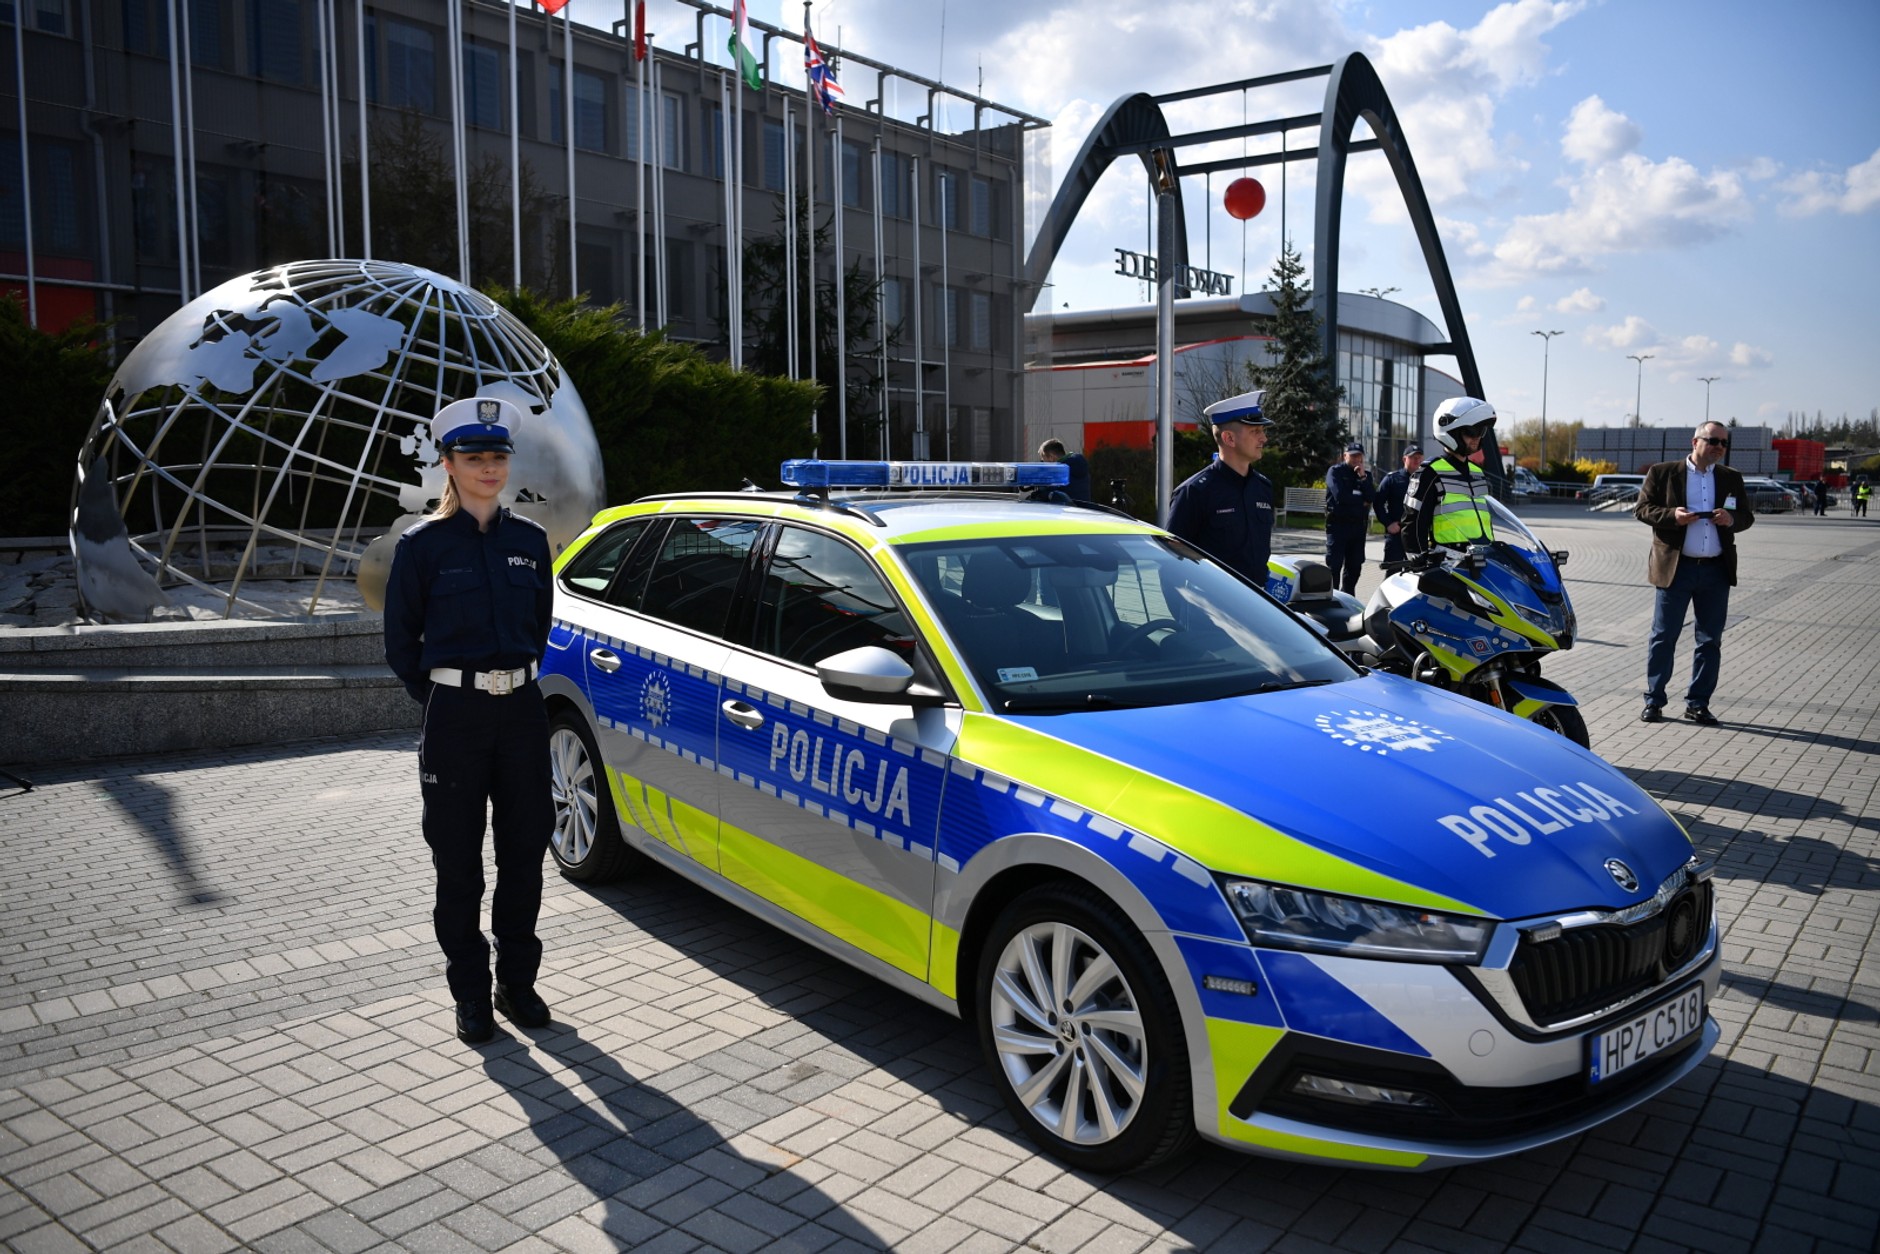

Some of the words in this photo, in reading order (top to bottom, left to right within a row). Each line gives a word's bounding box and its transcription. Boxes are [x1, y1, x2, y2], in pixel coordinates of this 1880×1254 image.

[507, 555, 537, 570] POLCJA
[769, 721, 911, 827] POLICJA
[1436, 781, 1640, 858] POLICJA
[1605, 1017, 1648, 1075] HPZ
[1654, 992, 1698, 1049] C518
